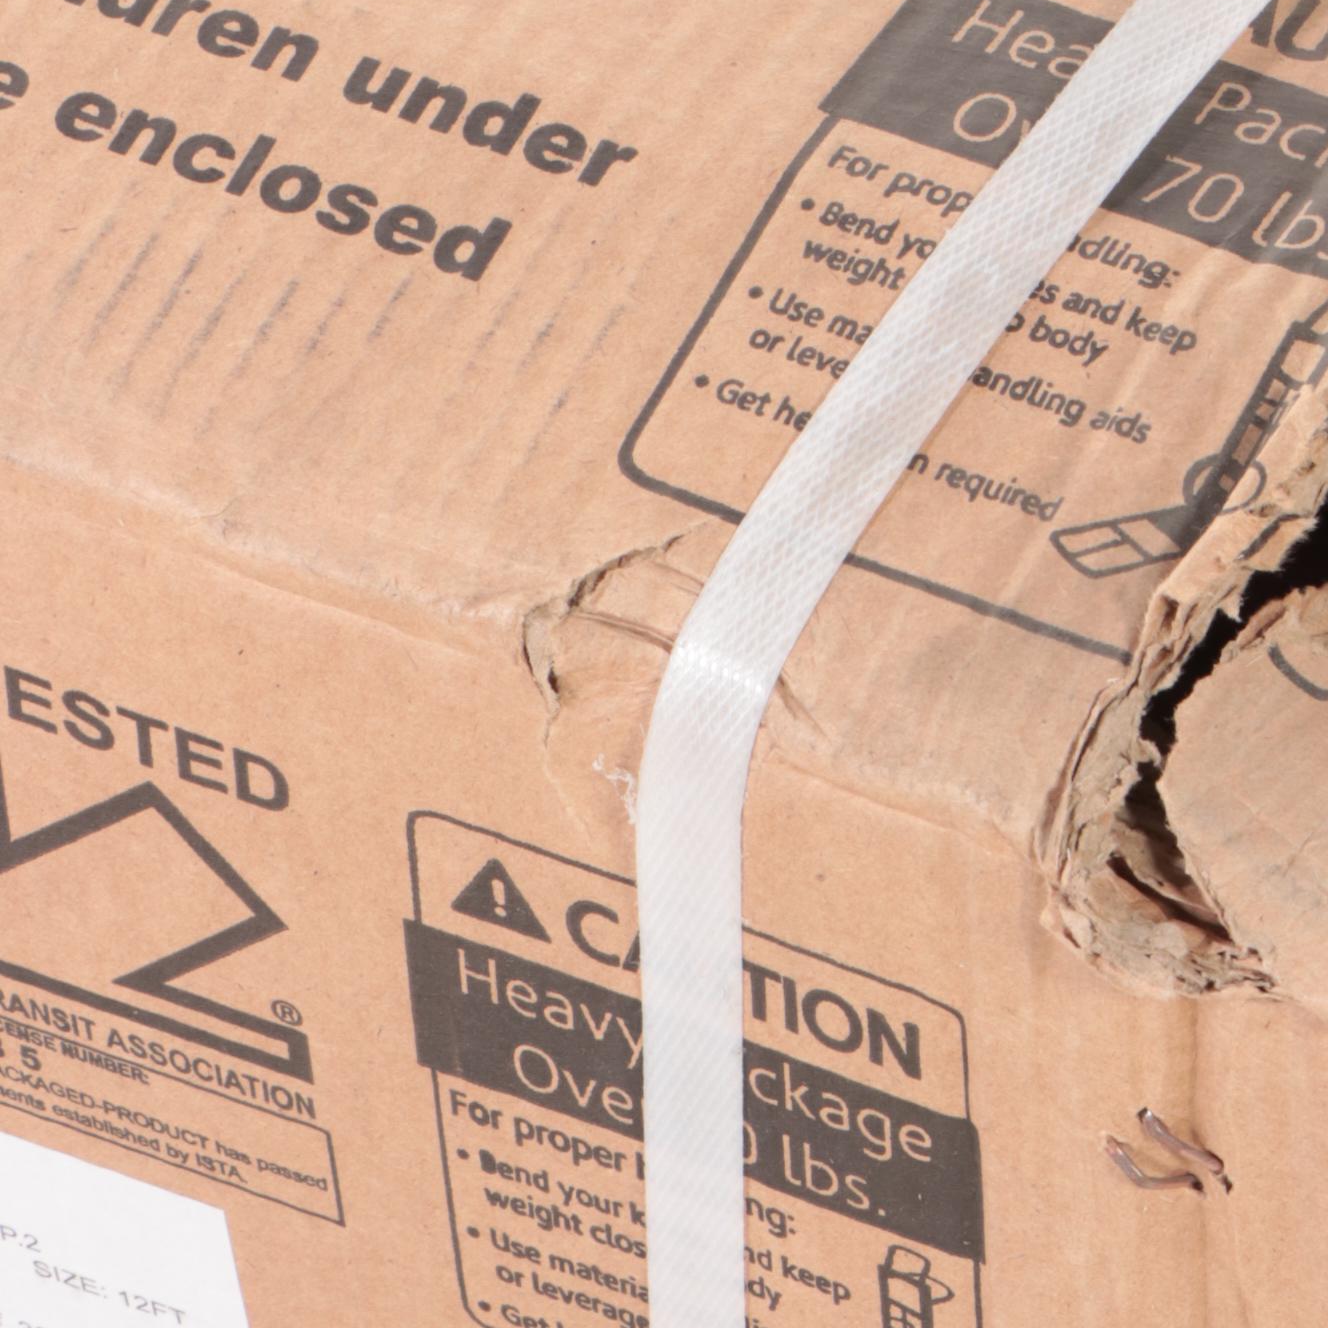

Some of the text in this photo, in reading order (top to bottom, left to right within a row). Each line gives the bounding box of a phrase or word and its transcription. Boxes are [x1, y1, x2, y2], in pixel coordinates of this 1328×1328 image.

[343, 56, 637, 186] under
[827, 145, 889, 181] For
[883, 172, 975, 218] prop
[55, 91, 512, 282] enclosed
[1141, 154, 1245, 224] 70
[802, 240, 907, 291] weight
[1028, 314, 1110, 368] body
[818, 201, 900, 245] Bend
[896, 232, 938, 260] yo
[1062, 290, 1126, 326] and
[1124, 306, 1198, 356] keep
[748, 328, 786, 354] or
[785, 336, 851, 381] leve
[768, 287, 1152, 444] Use andling aids
[715, 378, 771, 417] Get
[772, 395, 814, 433] he
[933, 458, 1065, 523] required
[0, 1021, 57, 1052] ENSE
[61, 1041, 150, 1085] NUMBER:
[565, 900, 922, 1081] CTION
[0, 989, 316, 1120] ANSIT ASSOCIATION
[457, 947, 933, 1163] Heavy ckage
[0, 1066, 329, 1192] CKAGED-PRODUCT has passed
[52, 1104, 161, 1154] established
[166, 1141, 190, 1164] by
[194, 1152, 249, 1184] ISTA.
[449, 1088, 502, 1130] For
[514, 1116, 627, 1172] proper
[513, 1044, 643, 1125] Ove
[782, 1133, 887, 1217] lbs.
[32, 1258, 188, 1326] SIZE: 12FT
[484, 1187, 783, 1312] weight clos dy
[489, 1227, 542, 1265] Use
[548, 1253, 648, 1304] materia
[495, 1264, 526, 1287] or
[557, 1180, 624, 1218] your
[744, 1245, 773, 1272] nd
[781, 1255, 852, 1305] keep
